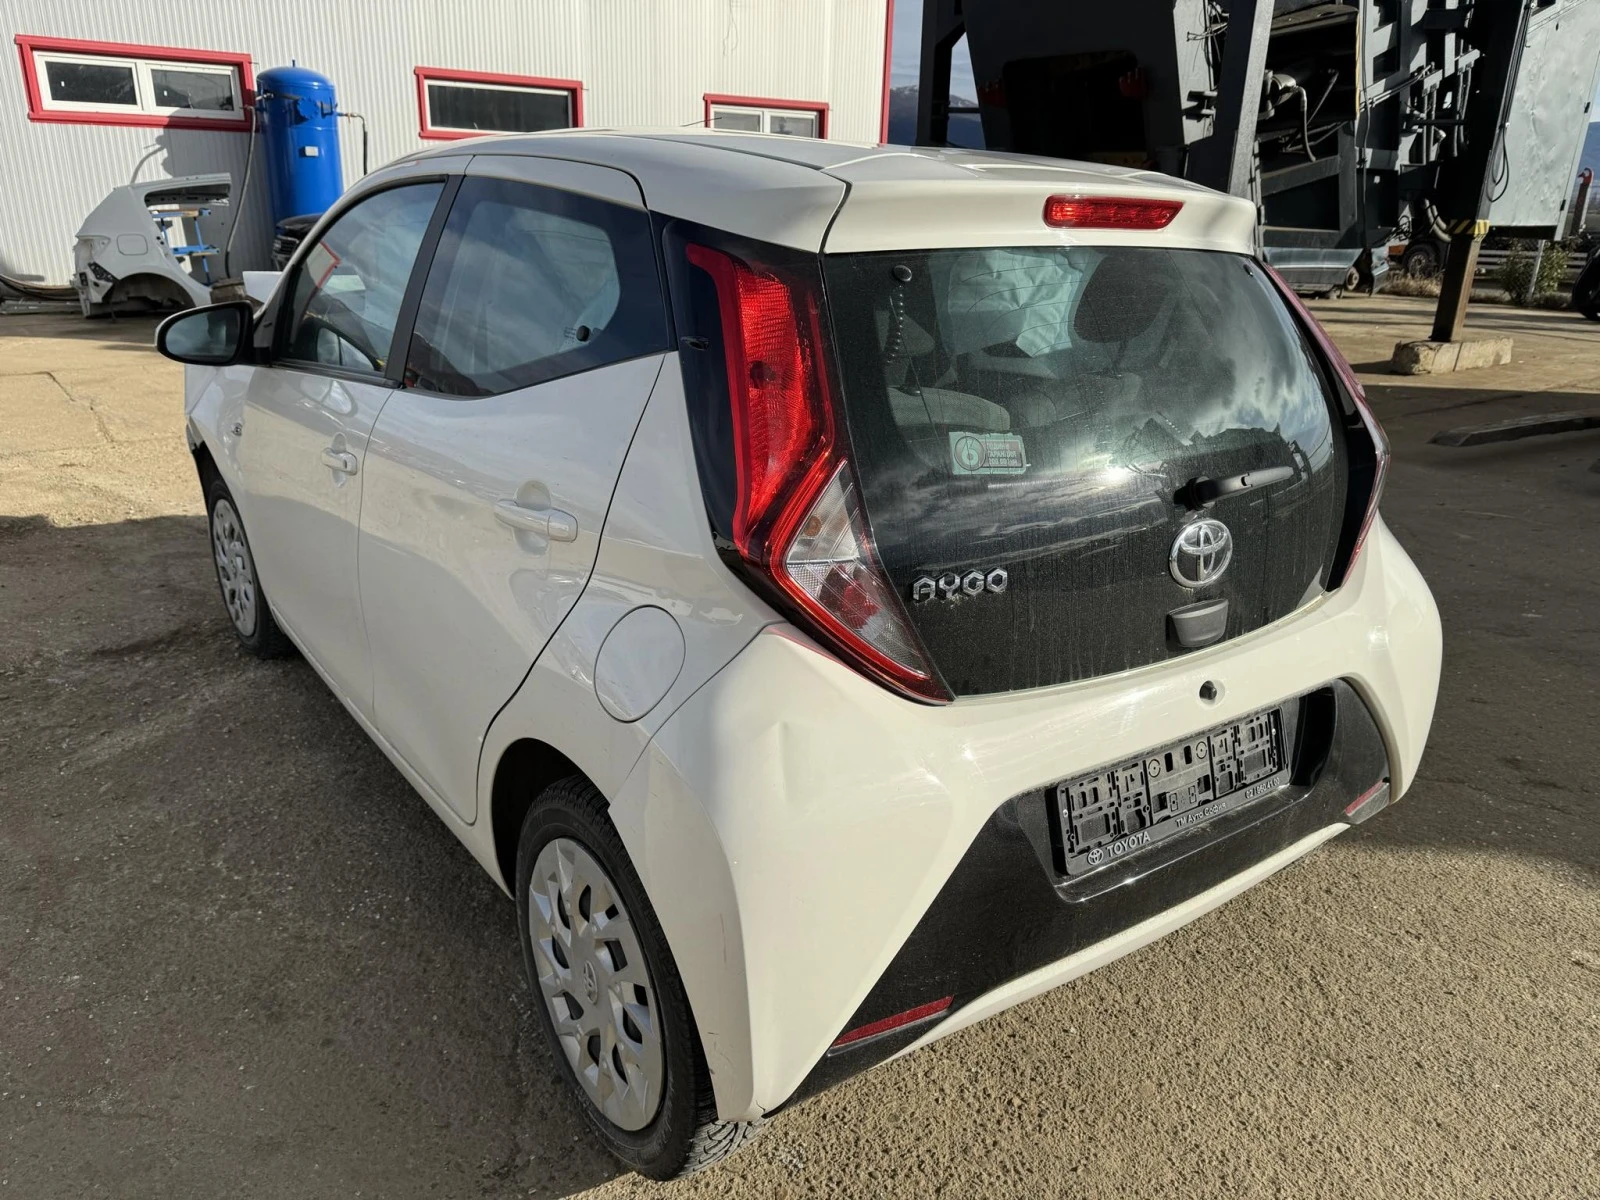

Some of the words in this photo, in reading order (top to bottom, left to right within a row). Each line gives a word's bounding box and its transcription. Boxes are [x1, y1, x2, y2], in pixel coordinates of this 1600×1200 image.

[912, 567, 1008, 601] AYGO
[1204, 802, 1227, 816] София
[1106, 831, 1151, 858] TOYOTA
